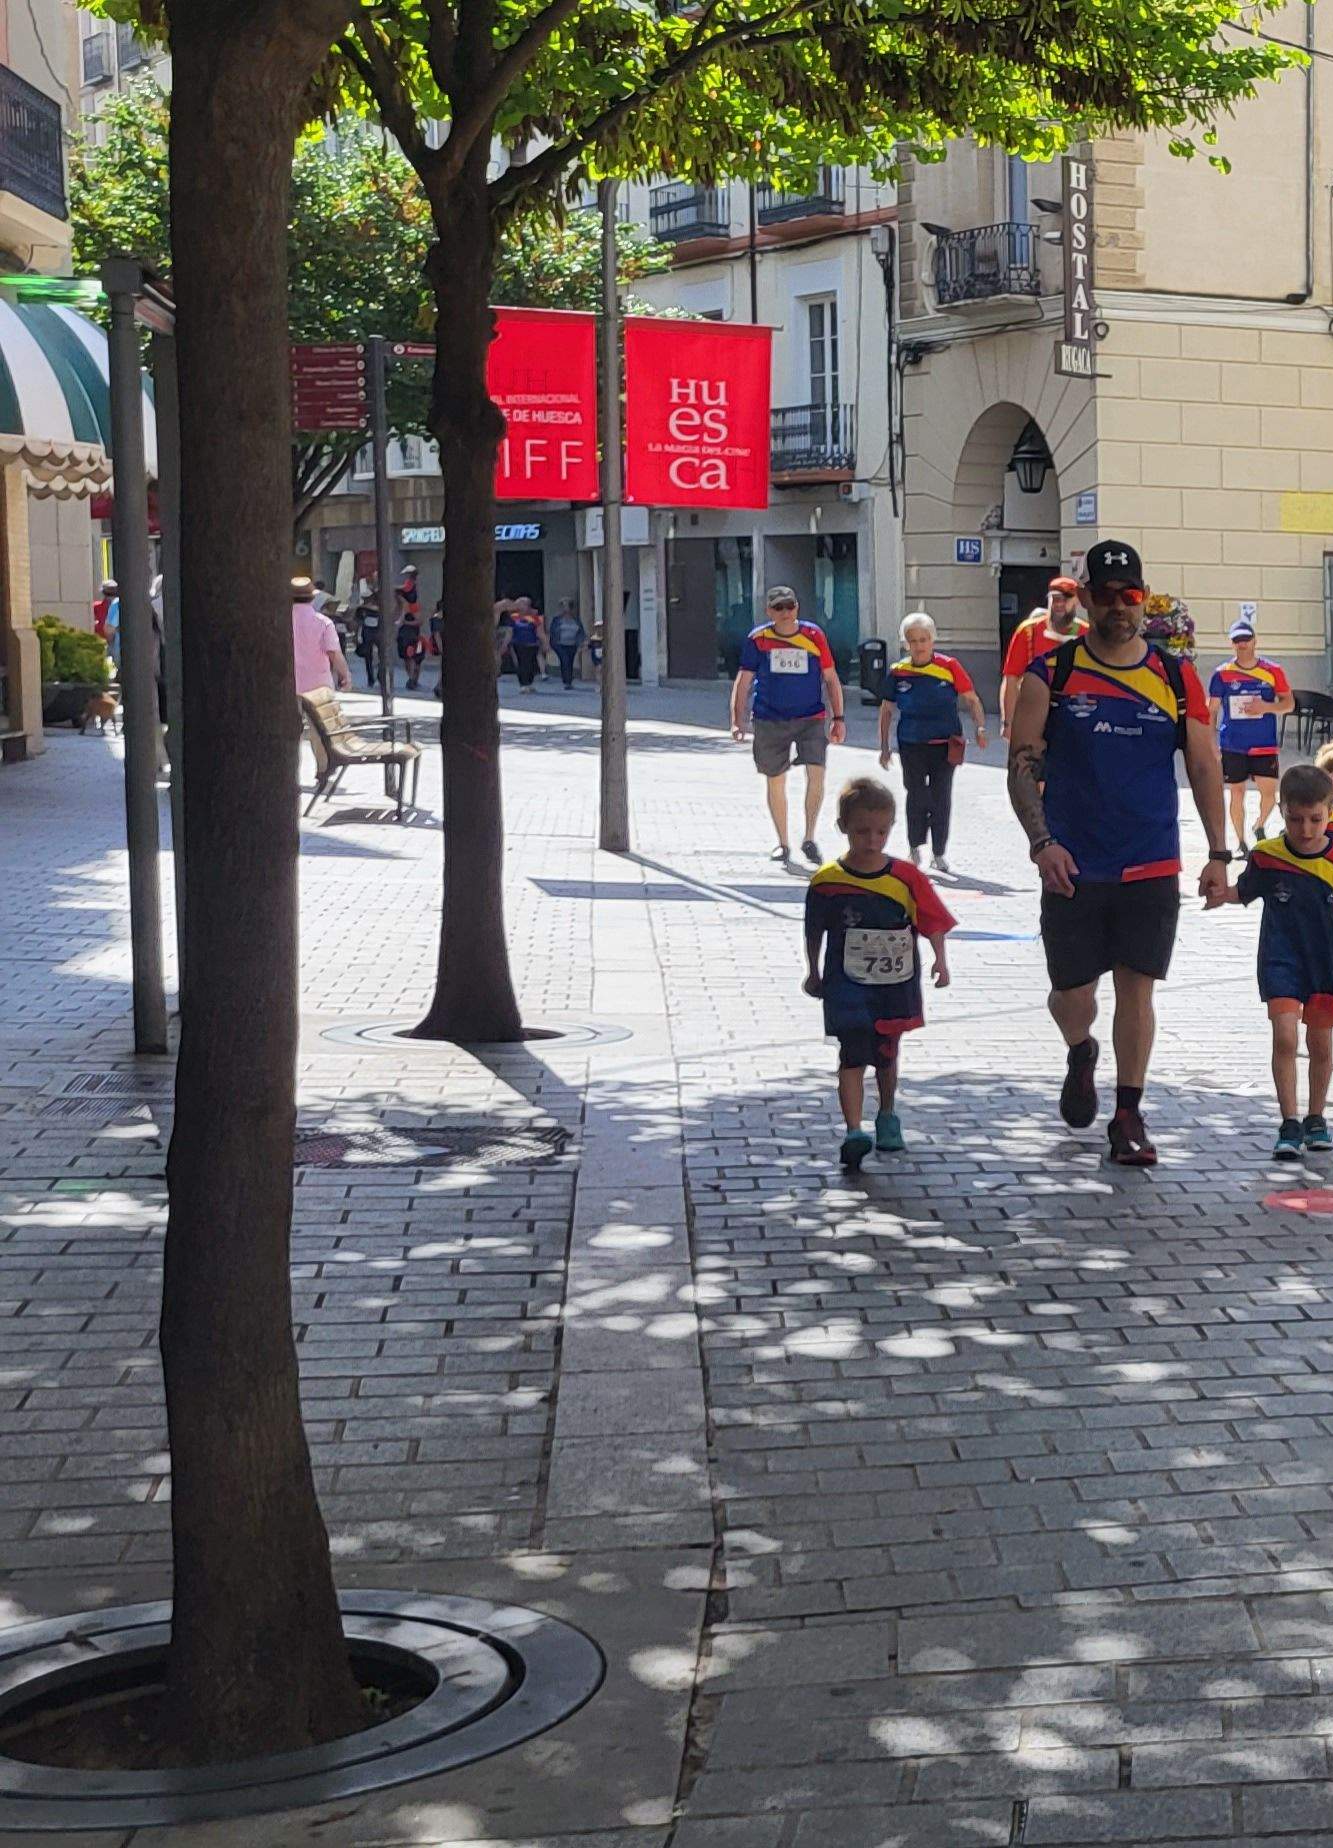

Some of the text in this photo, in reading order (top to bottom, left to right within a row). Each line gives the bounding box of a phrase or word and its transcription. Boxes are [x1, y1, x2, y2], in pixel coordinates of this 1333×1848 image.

[1069, 161, 1090, 341] HOSTAL
[513, 409, 530, 423] DE
[531, 410, 583, 425] HUESCA
[863, 955, 904, 973] 735
